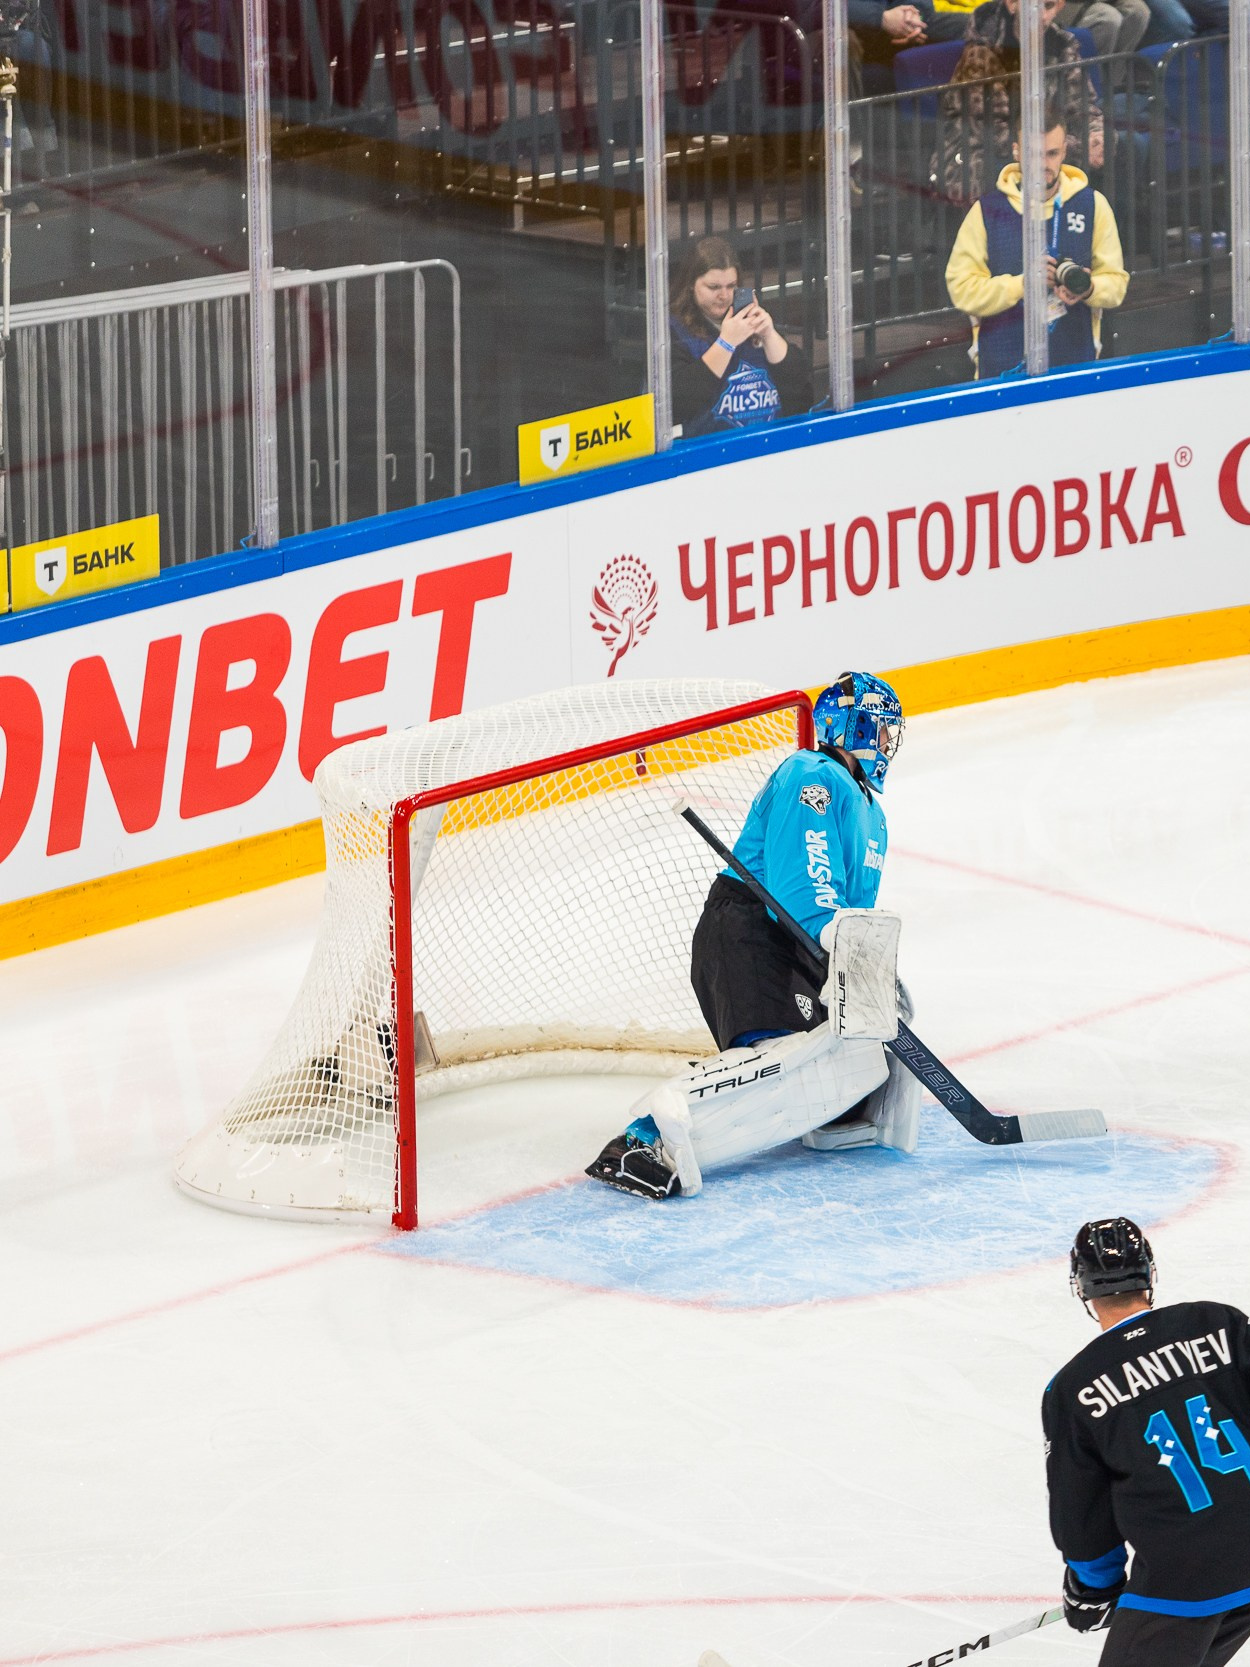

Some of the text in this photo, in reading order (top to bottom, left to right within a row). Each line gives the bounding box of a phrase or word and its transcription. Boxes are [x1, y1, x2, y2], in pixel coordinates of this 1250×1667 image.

[575, 420, 632, 454] БАНК
[73, 541, 136, 576] БАНК
[837, 971, 846, 1035] TRUE
[689, 1062, 782, 1098] TRUE
[1077, 1328, 1233, 1419] SILANTYEV
